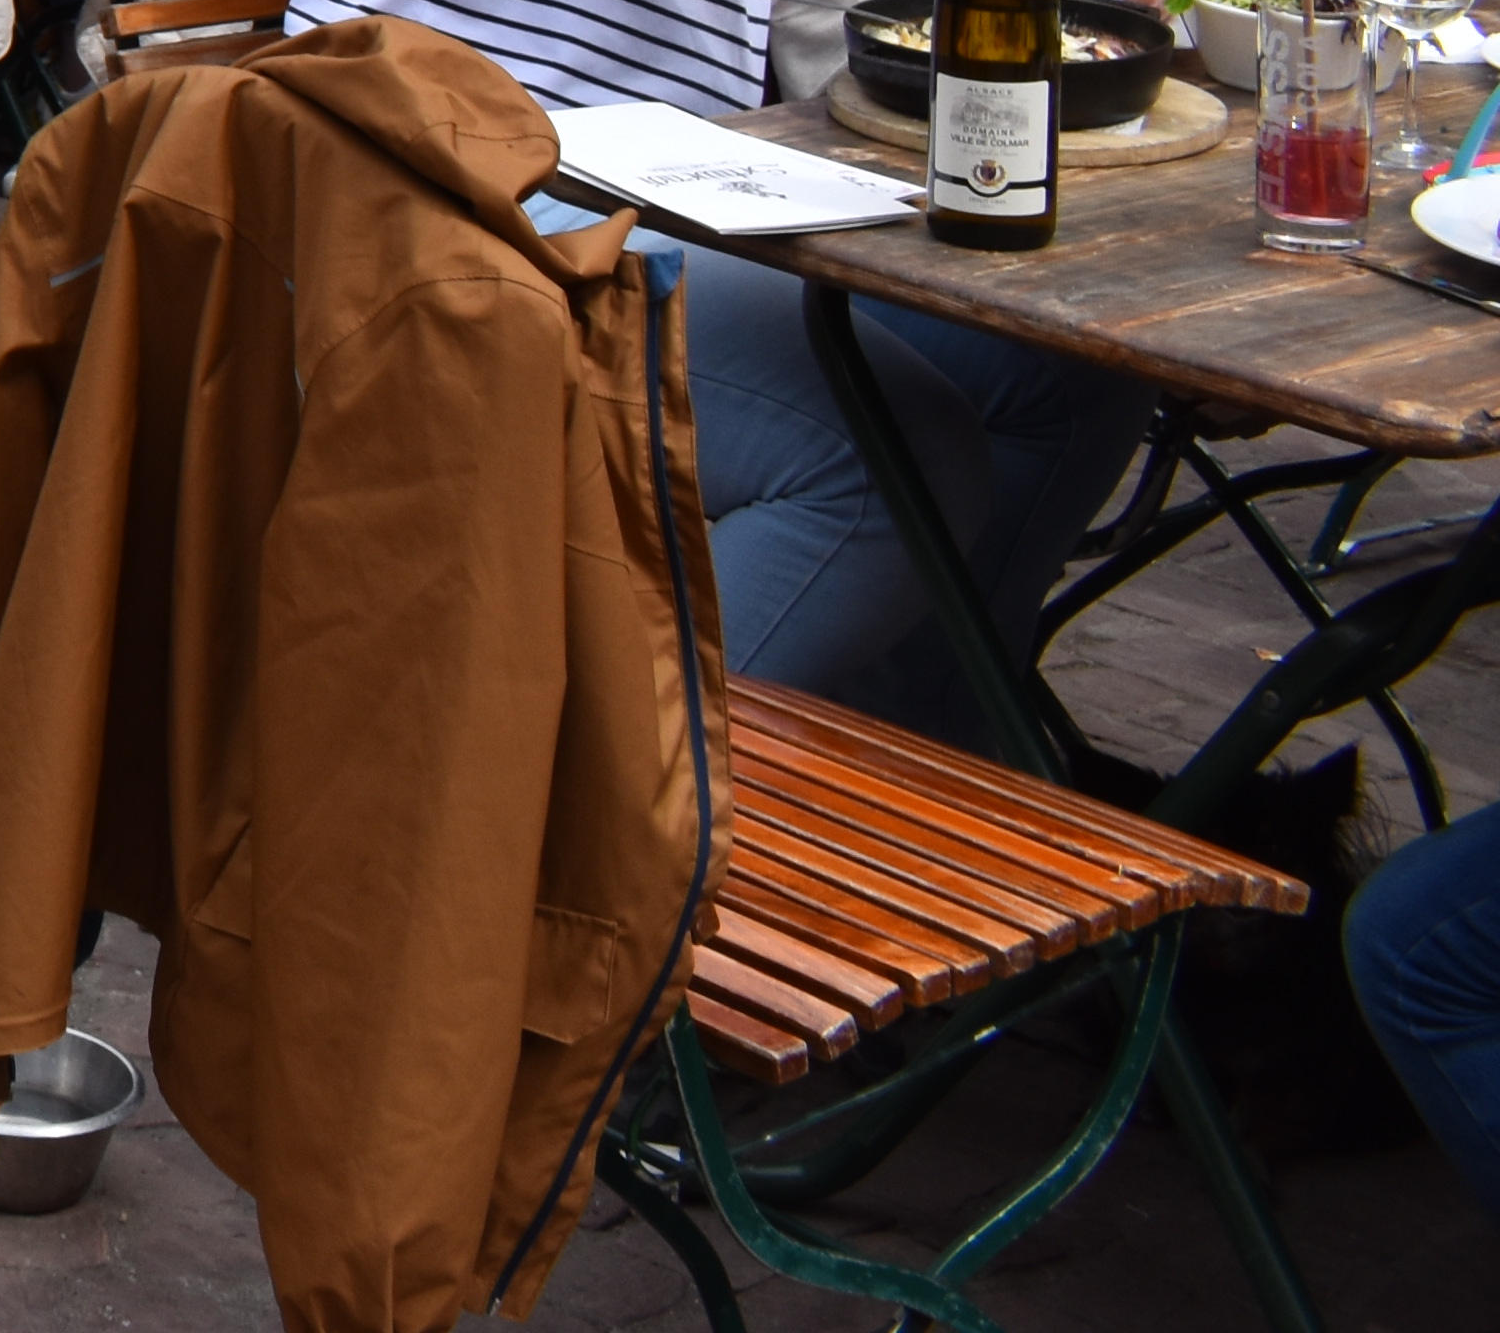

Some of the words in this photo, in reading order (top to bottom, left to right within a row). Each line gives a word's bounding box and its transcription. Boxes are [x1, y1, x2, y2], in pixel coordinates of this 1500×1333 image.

[966, 86, 1013, 95] ALSACE
[962, 125, 1015, 137] DOMAINE
[950, 134, 973, 145] VILLE
[976, 137, 986, 147] DE
[990, 138, 1029, 147] COLMAR
